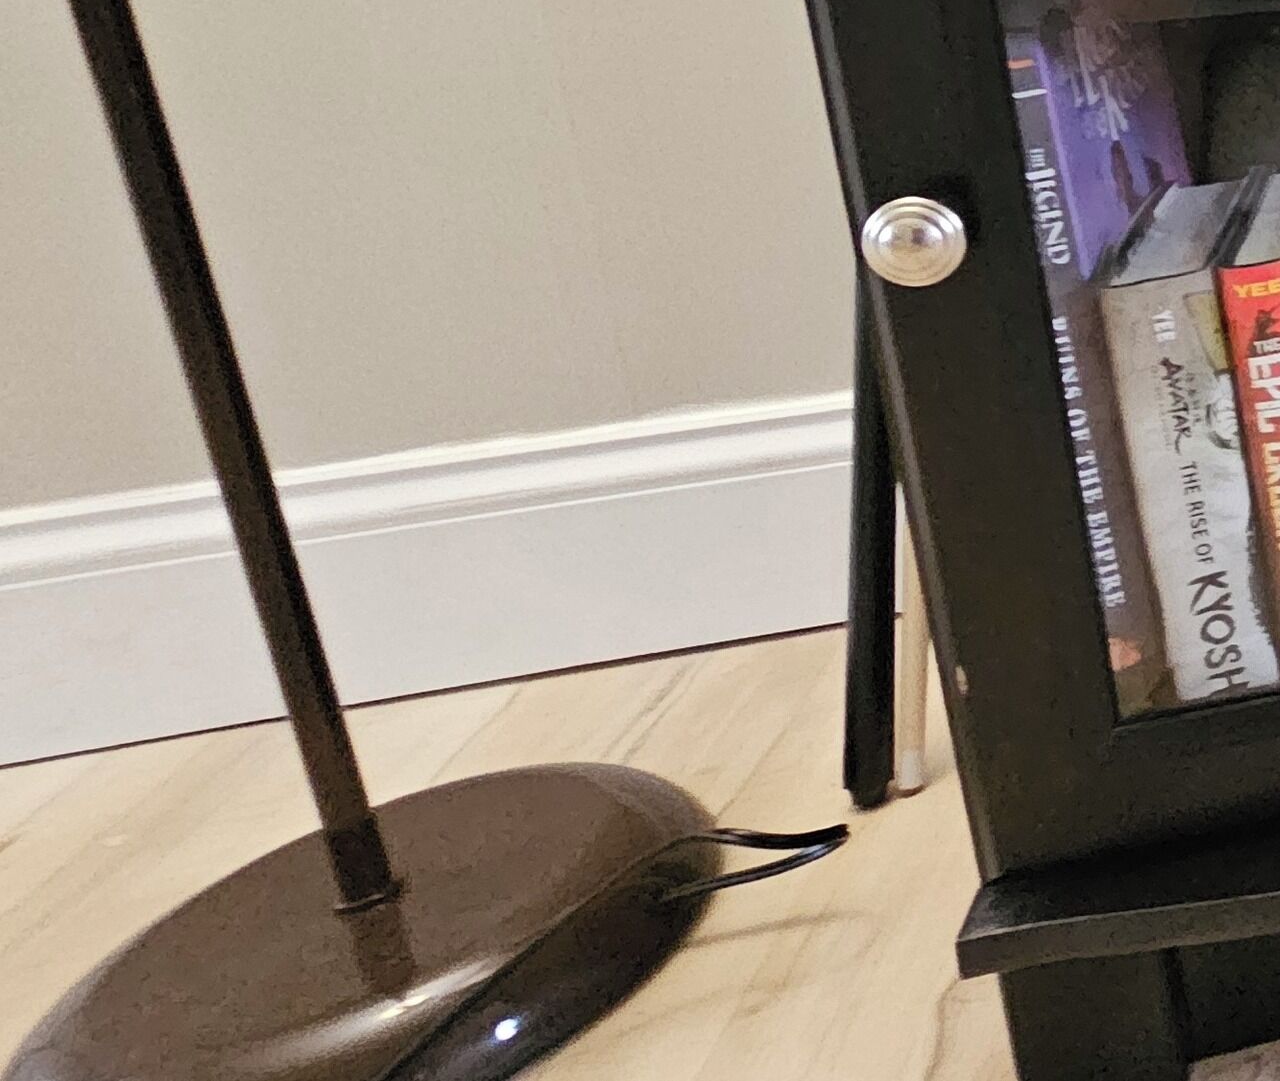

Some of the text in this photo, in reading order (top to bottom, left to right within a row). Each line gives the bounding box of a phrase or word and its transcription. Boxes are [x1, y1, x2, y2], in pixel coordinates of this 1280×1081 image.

[1179, 461, 1202, 497] THE
[1186, 500, 1212, 540] RISE
[1195, 543, 1215, 565] OF
